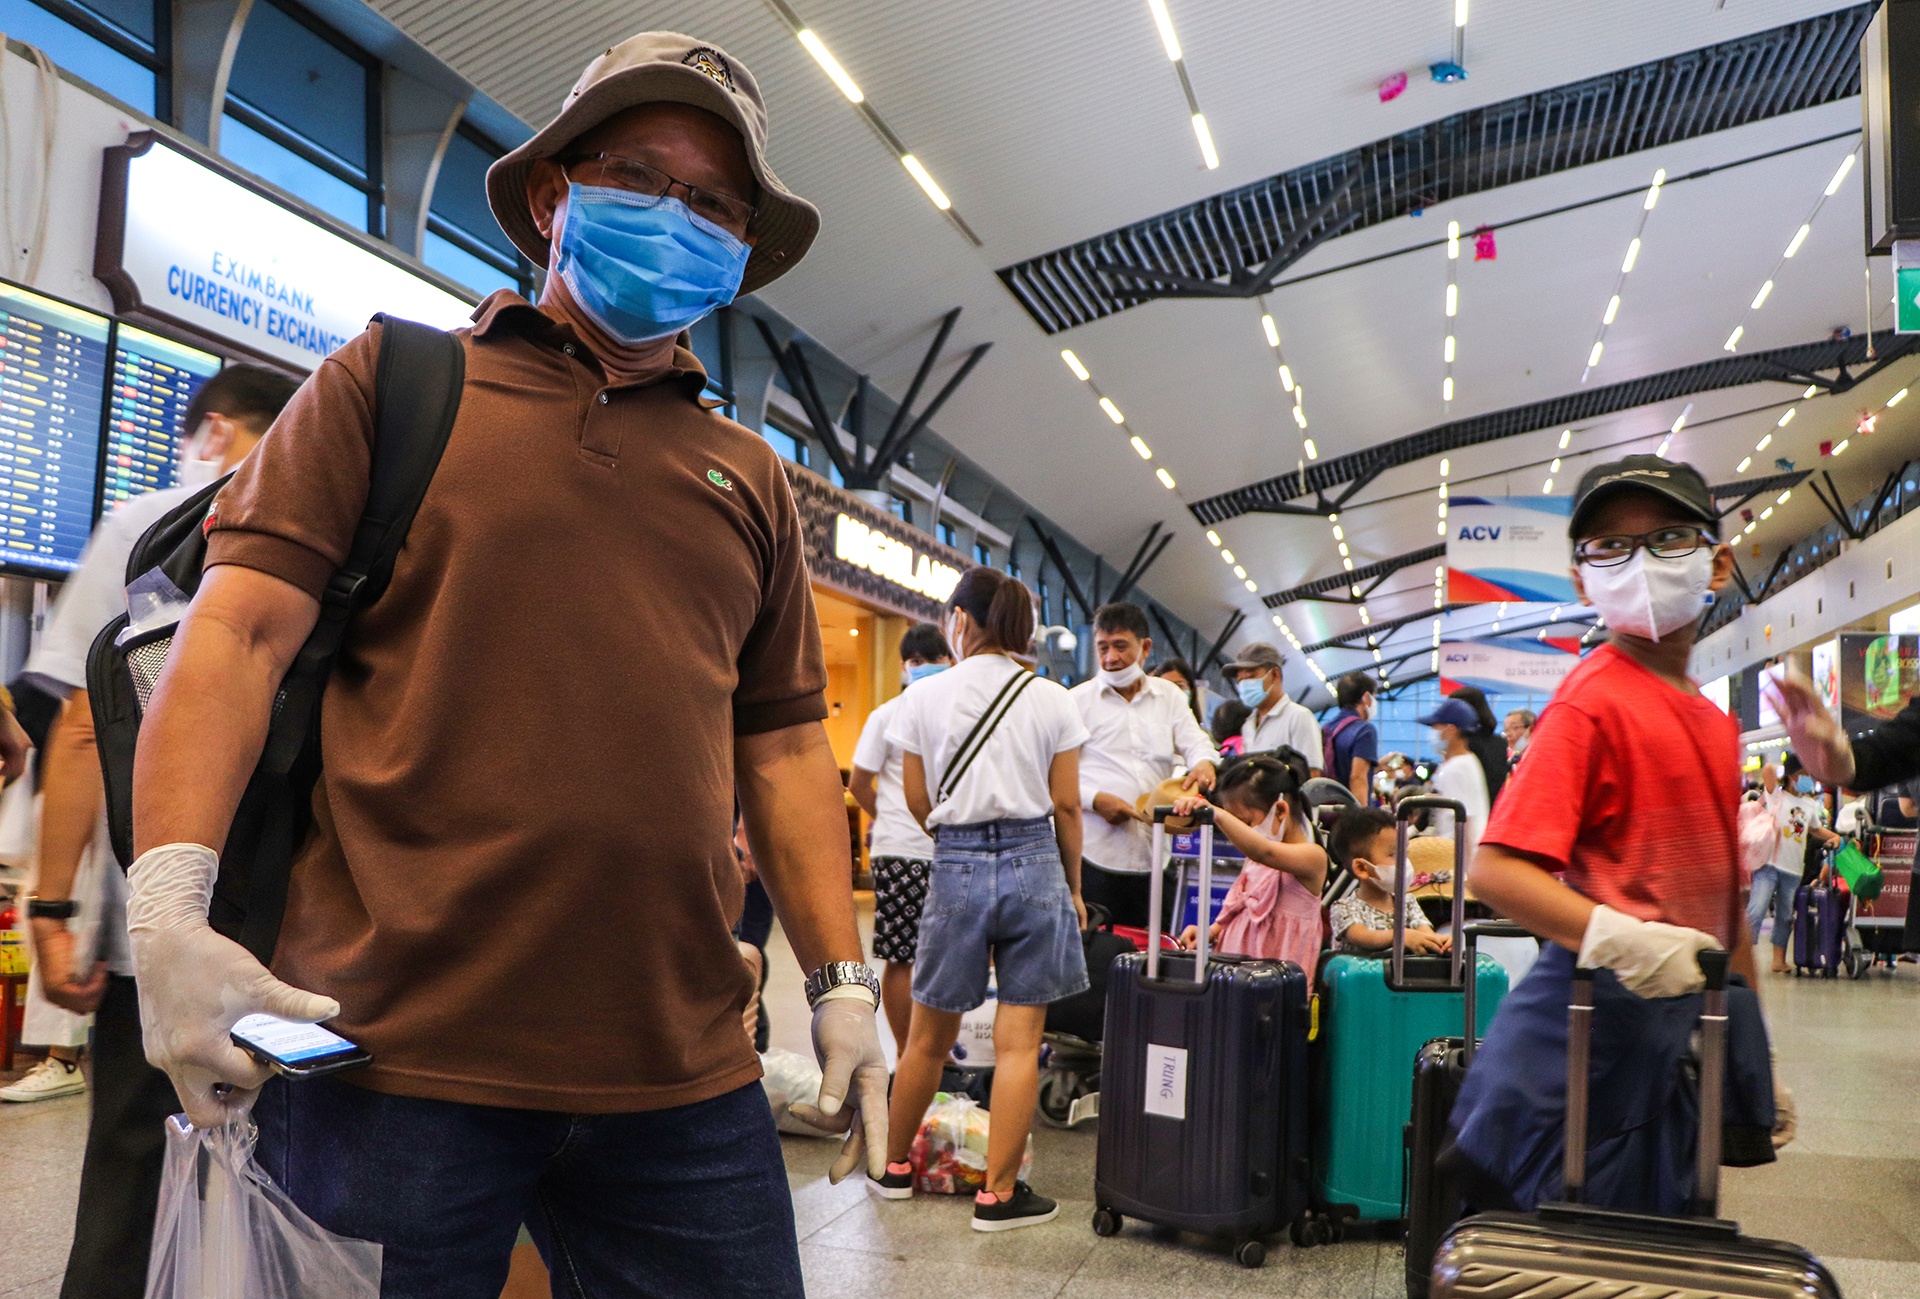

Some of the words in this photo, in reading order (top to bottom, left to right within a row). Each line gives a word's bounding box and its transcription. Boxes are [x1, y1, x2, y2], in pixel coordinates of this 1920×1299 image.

[167, 264, 263, 329] CURRENCY
[212, 250, 316, 317] EXIMBANK
[1459, 525, 1501, 541] ACV
[1446, 653, 1469, 662] ACV
[1160, 1056, 1176, 1099] TRUNG
